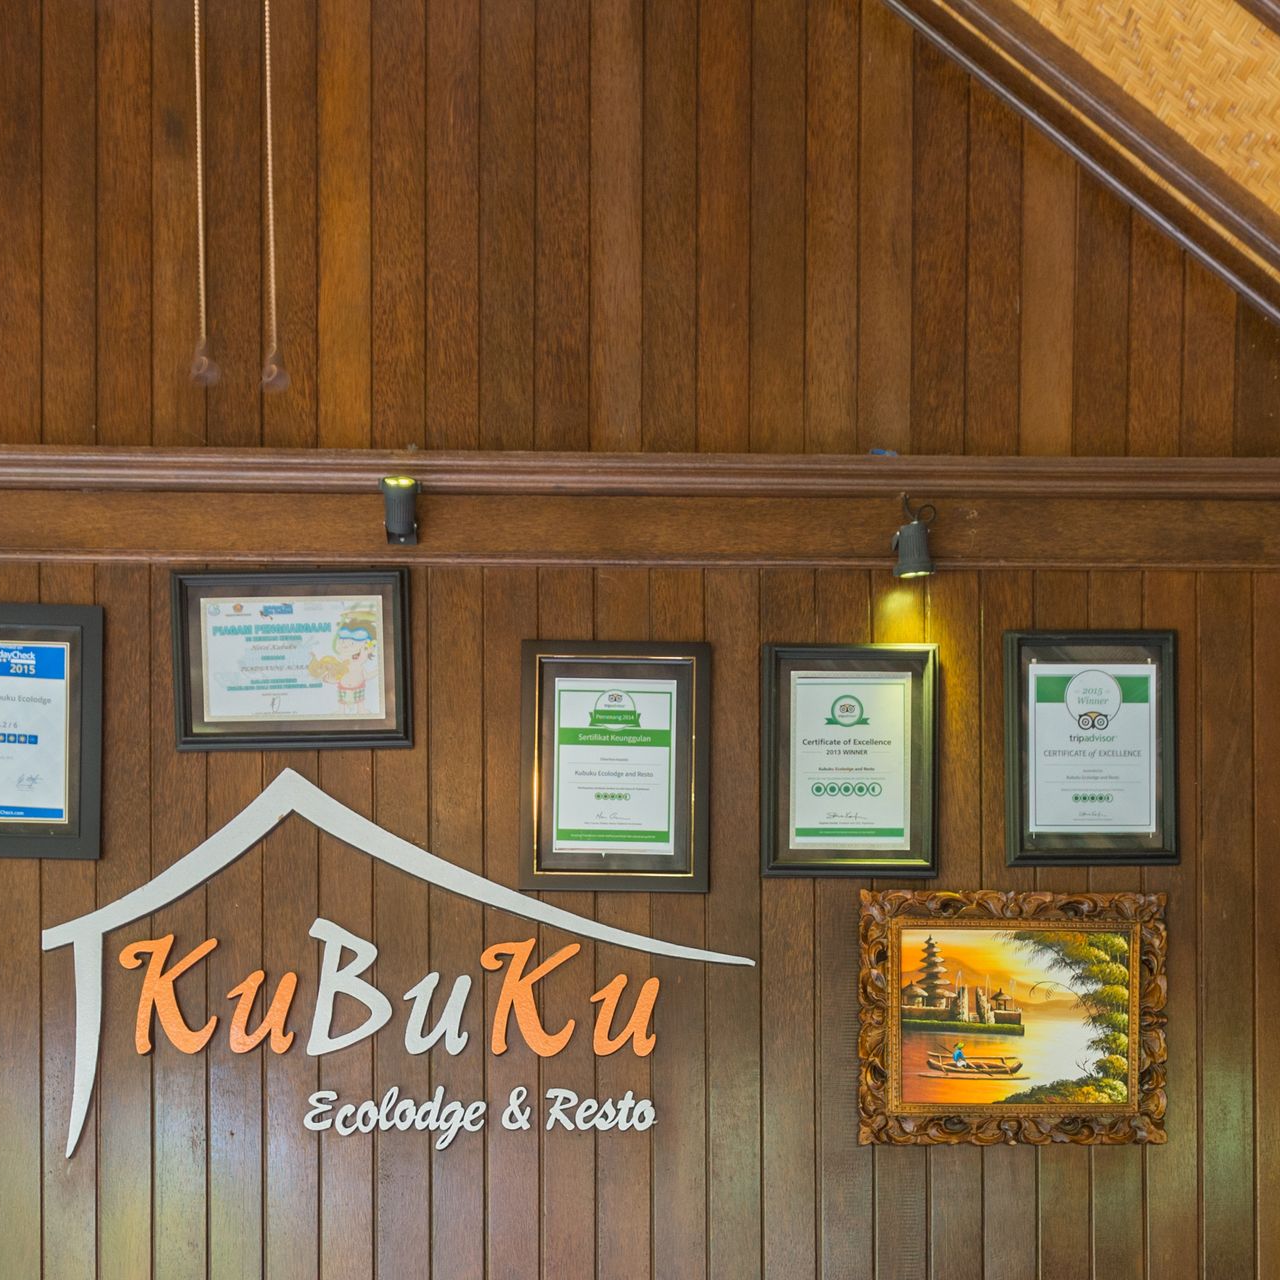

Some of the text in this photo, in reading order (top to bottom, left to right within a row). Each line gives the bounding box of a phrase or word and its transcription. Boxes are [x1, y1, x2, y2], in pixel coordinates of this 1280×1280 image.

[10, 664, 36, 674] 2015
[1082, 687, 1103, 696] 2015
[18, 695, 52, 705] Ecolodge
[1077, 696, 1109, 705] Winner
[578, 733, 651, 744] Sertifikat Keunggulan
[1069, 734, 1115, 743] tripadvisor
[1087, 749, 1098, 758] of
[598, 770, 624, 778] Ecolodge
[118, 916, 662, 1058] KuBuKu
[302, 1085, 657, 1152] Ecolodge & Resto
